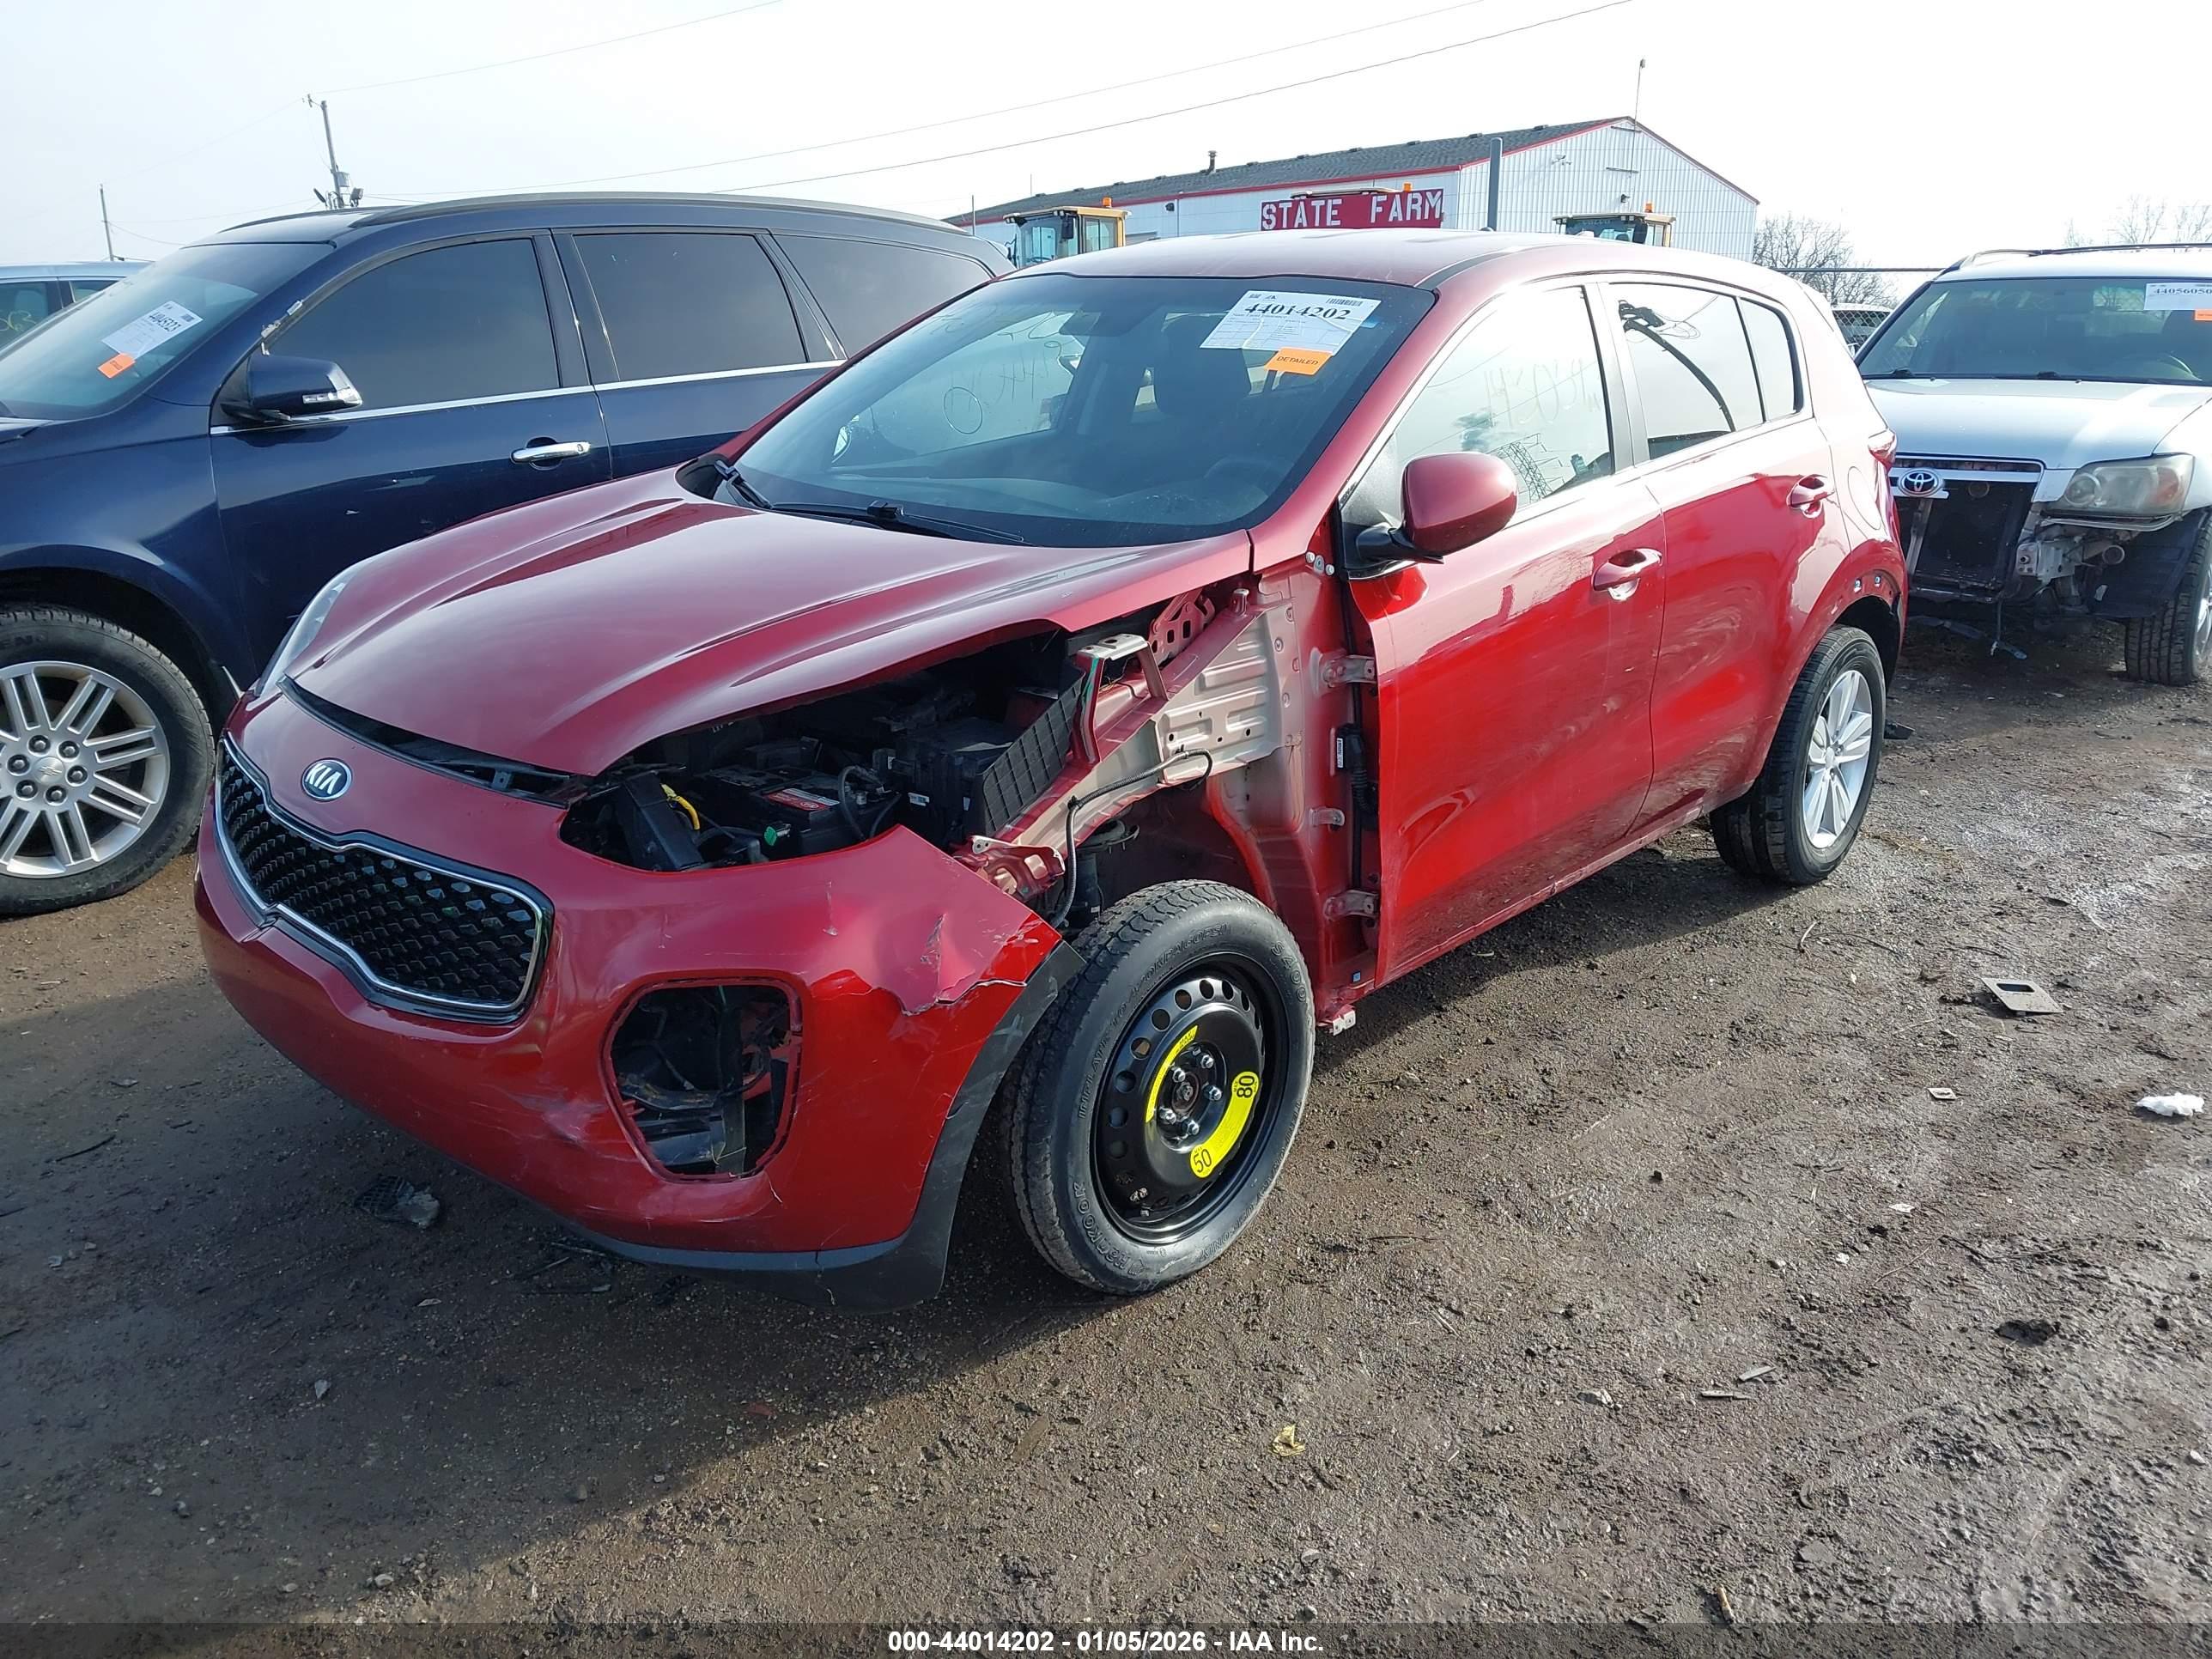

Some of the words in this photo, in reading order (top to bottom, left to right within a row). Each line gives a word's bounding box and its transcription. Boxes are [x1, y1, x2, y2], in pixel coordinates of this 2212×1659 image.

[1262, 198, 1342, 230] STATE
[1370, 191, 1443, 223] FARM
[1245, 303, 1351, 319] 44014202
[1276, 356, 1319, 365] DETAILED
[1237, 1075, 1255, 1098] 80
[1193, 1148, 1212, 1173] 50
